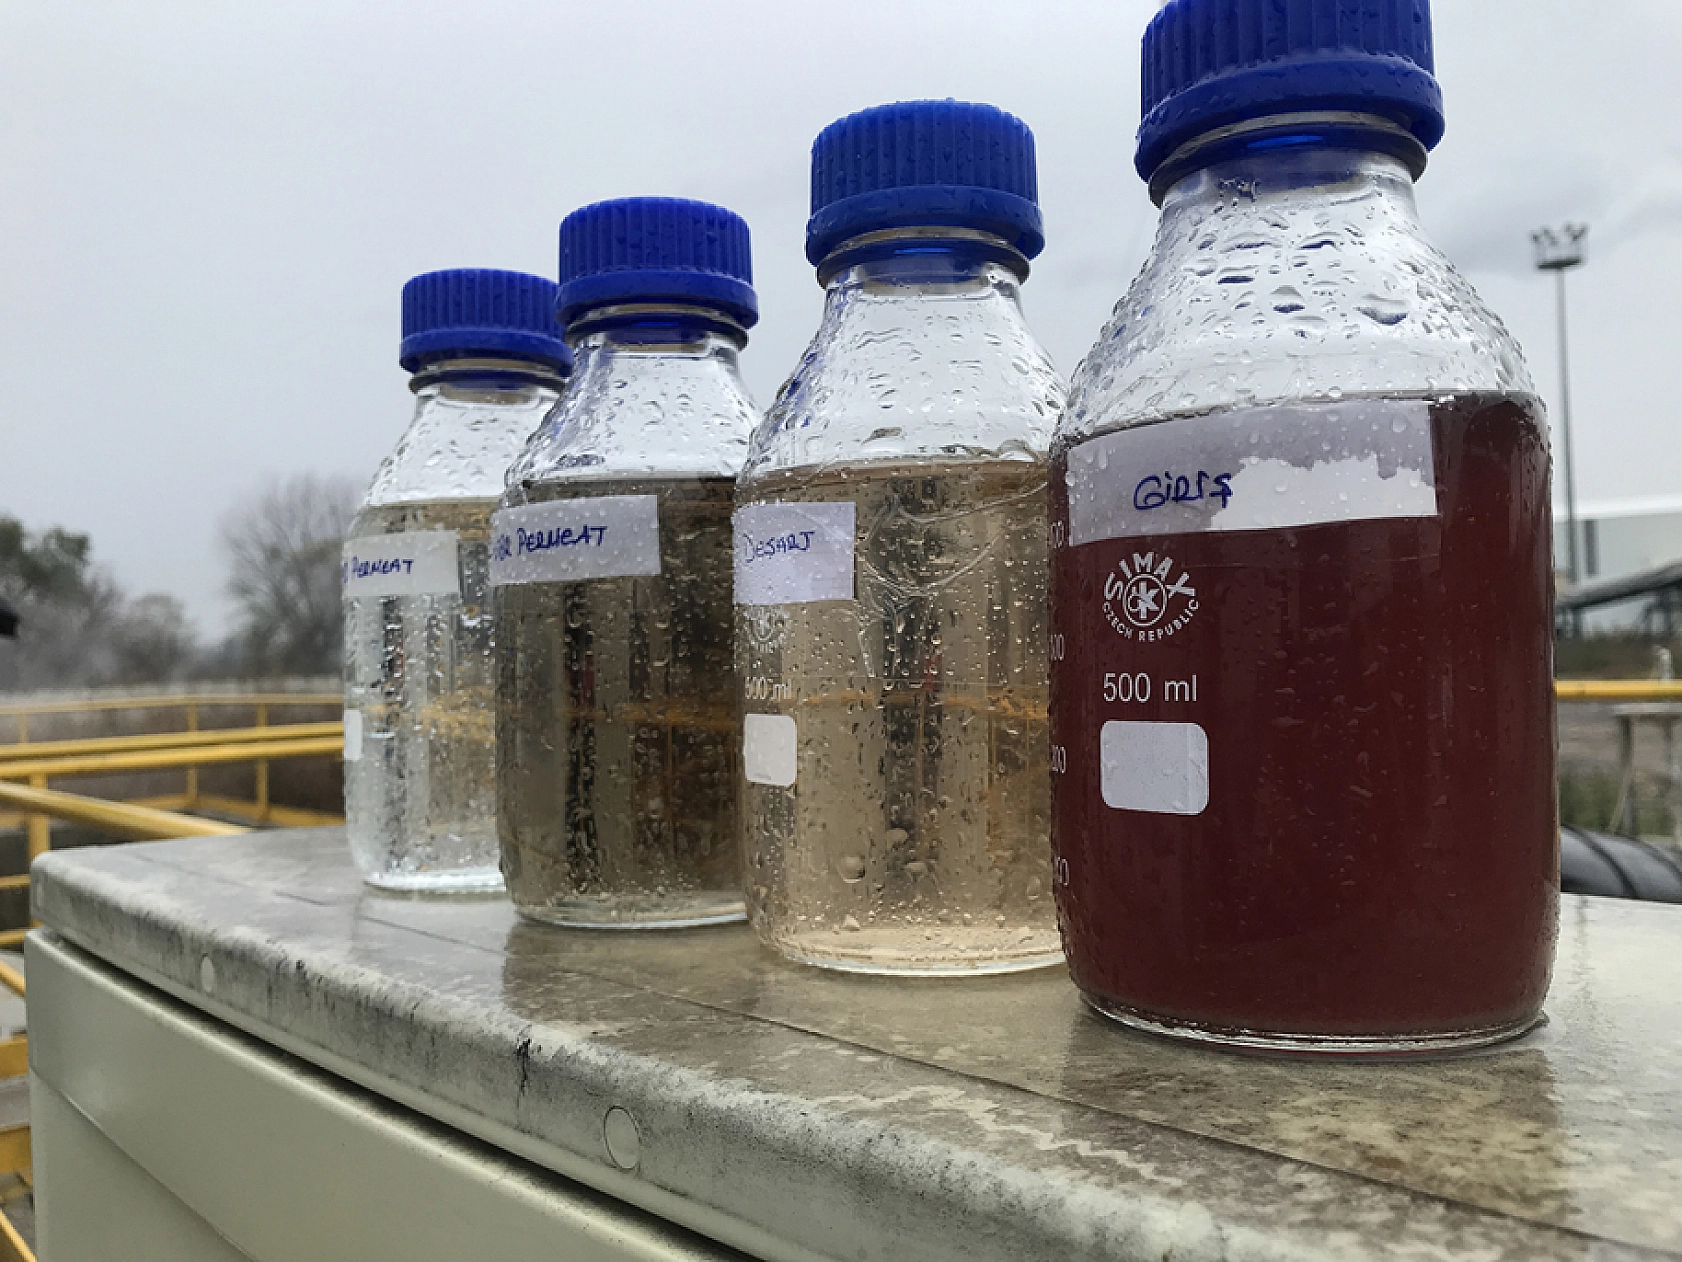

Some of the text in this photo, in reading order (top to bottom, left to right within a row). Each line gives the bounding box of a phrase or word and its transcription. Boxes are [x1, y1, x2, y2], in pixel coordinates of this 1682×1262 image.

[1103, 551, 1196, 601] SIMAX
[1102, 601, 1133, 640] CZECH
[1137, 599, 1199, 642] REPUBLIC
[1103, 672, 1197, 702] 500 ml
